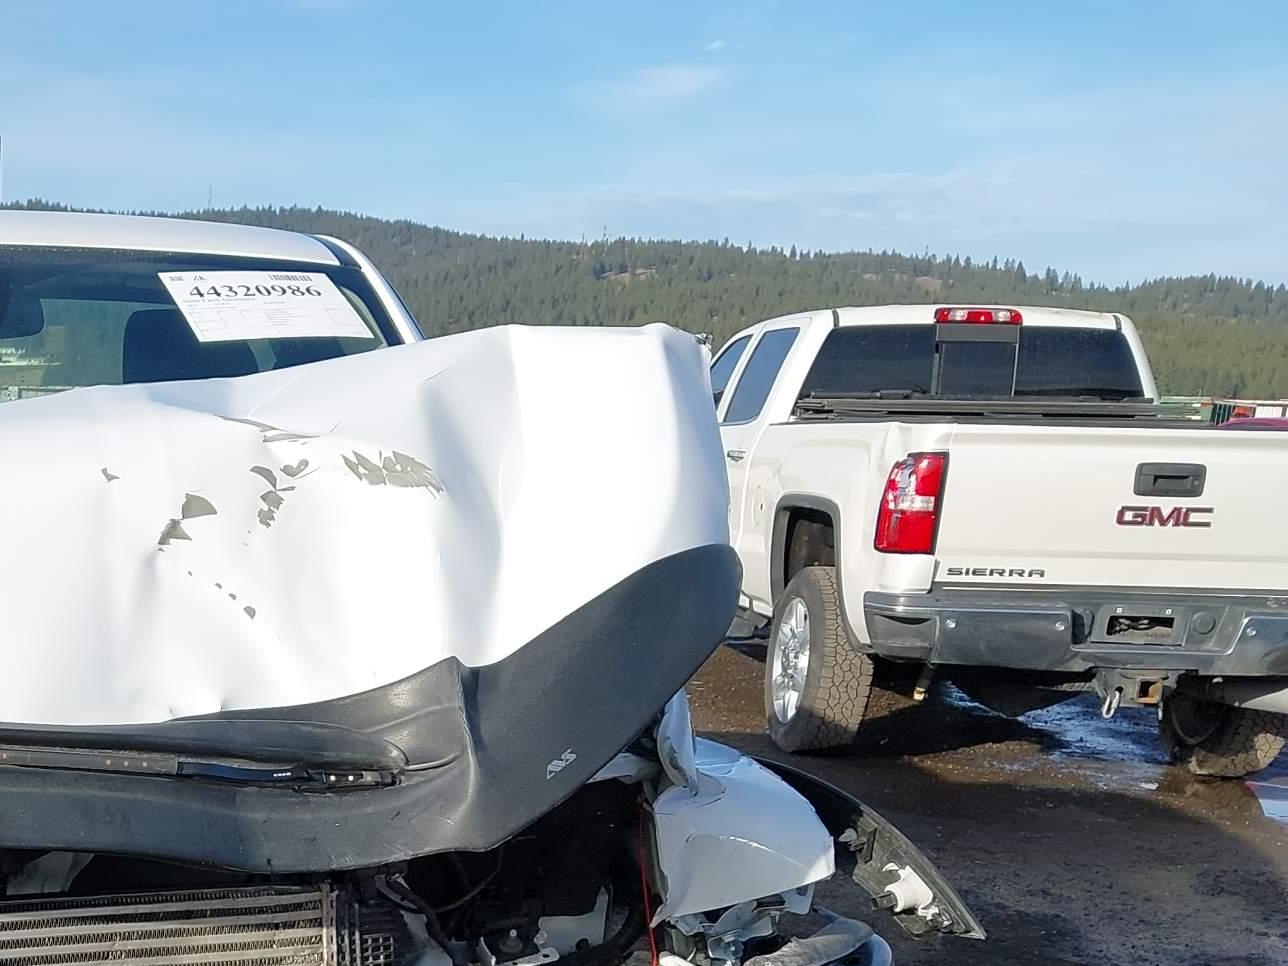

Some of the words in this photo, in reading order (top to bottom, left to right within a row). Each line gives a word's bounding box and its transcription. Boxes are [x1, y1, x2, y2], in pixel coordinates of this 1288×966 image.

[189, 284, 322, 298] 44320986
[1115, 505, 1215, 528] GMC
[946, 567, 1046, 578] SIERRA
